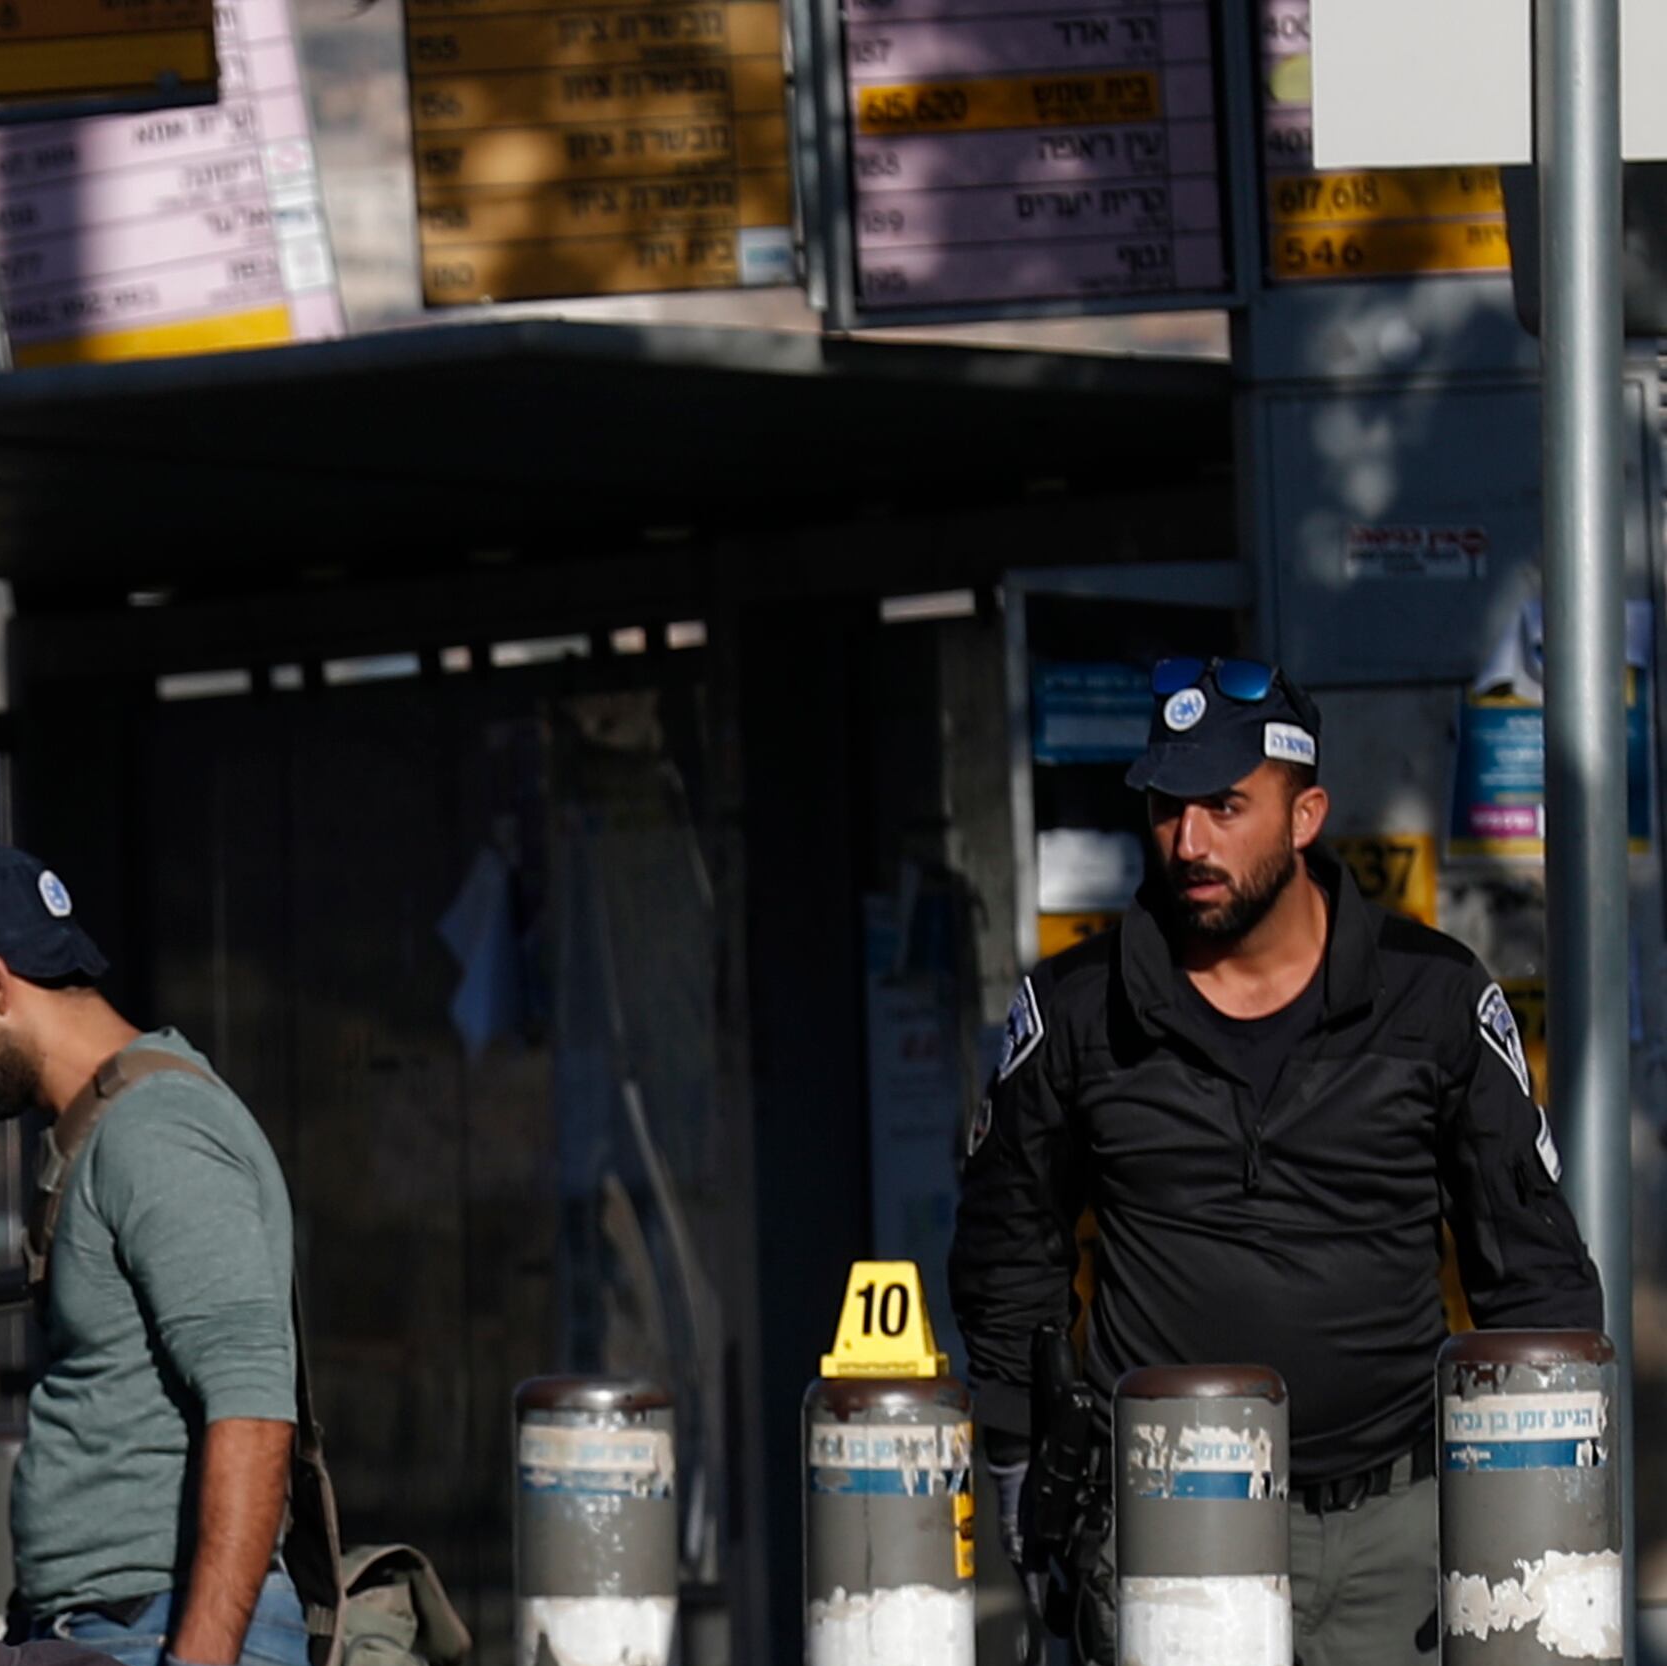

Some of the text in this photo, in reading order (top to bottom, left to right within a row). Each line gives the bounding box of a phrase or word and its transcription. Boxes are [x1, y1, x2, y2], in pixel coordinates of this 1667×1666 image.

[1285, 237, 1364, 269] 546
[856, 1280, 910, 1338] 10
[1488, 1411, 1510, 1434] בן
[1514, 1410, 1547, 1433] זמן
[1551, 1408, 1593, 1430] הגיע
